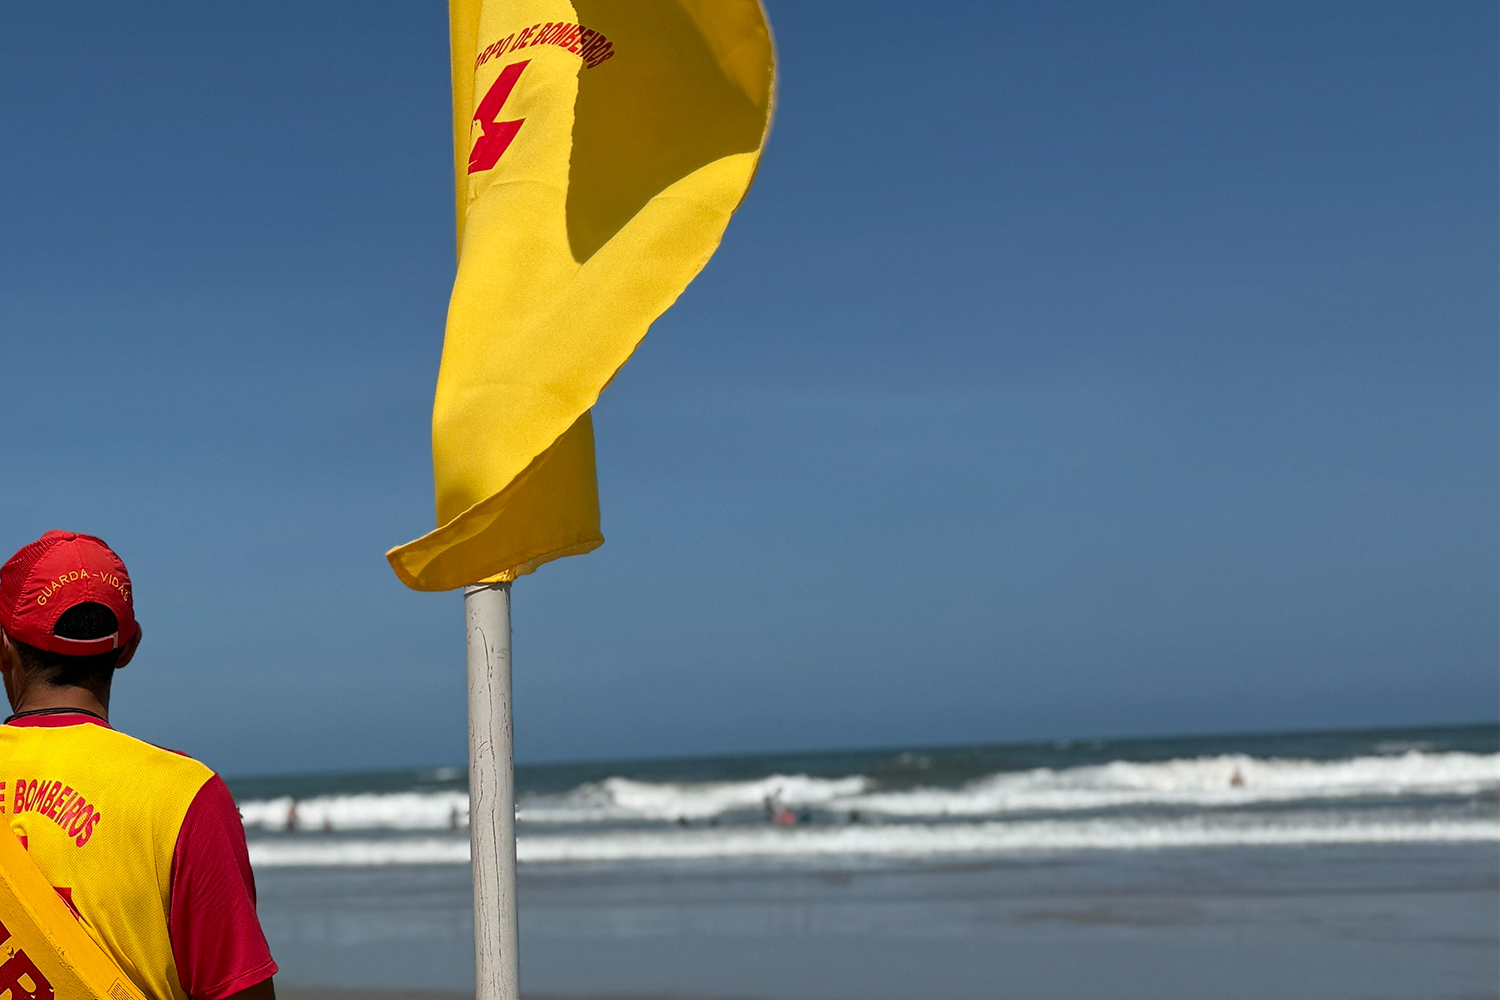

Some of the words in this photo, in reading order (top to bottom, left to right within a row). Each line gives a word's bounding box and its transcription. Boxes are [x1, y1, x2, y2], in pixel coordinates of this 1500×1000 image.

[508, 23, 542, 53] DE
[530, 22, 615, 69] BOMBEIROS
[13, 779, 101, 848] BOMBEIROS
